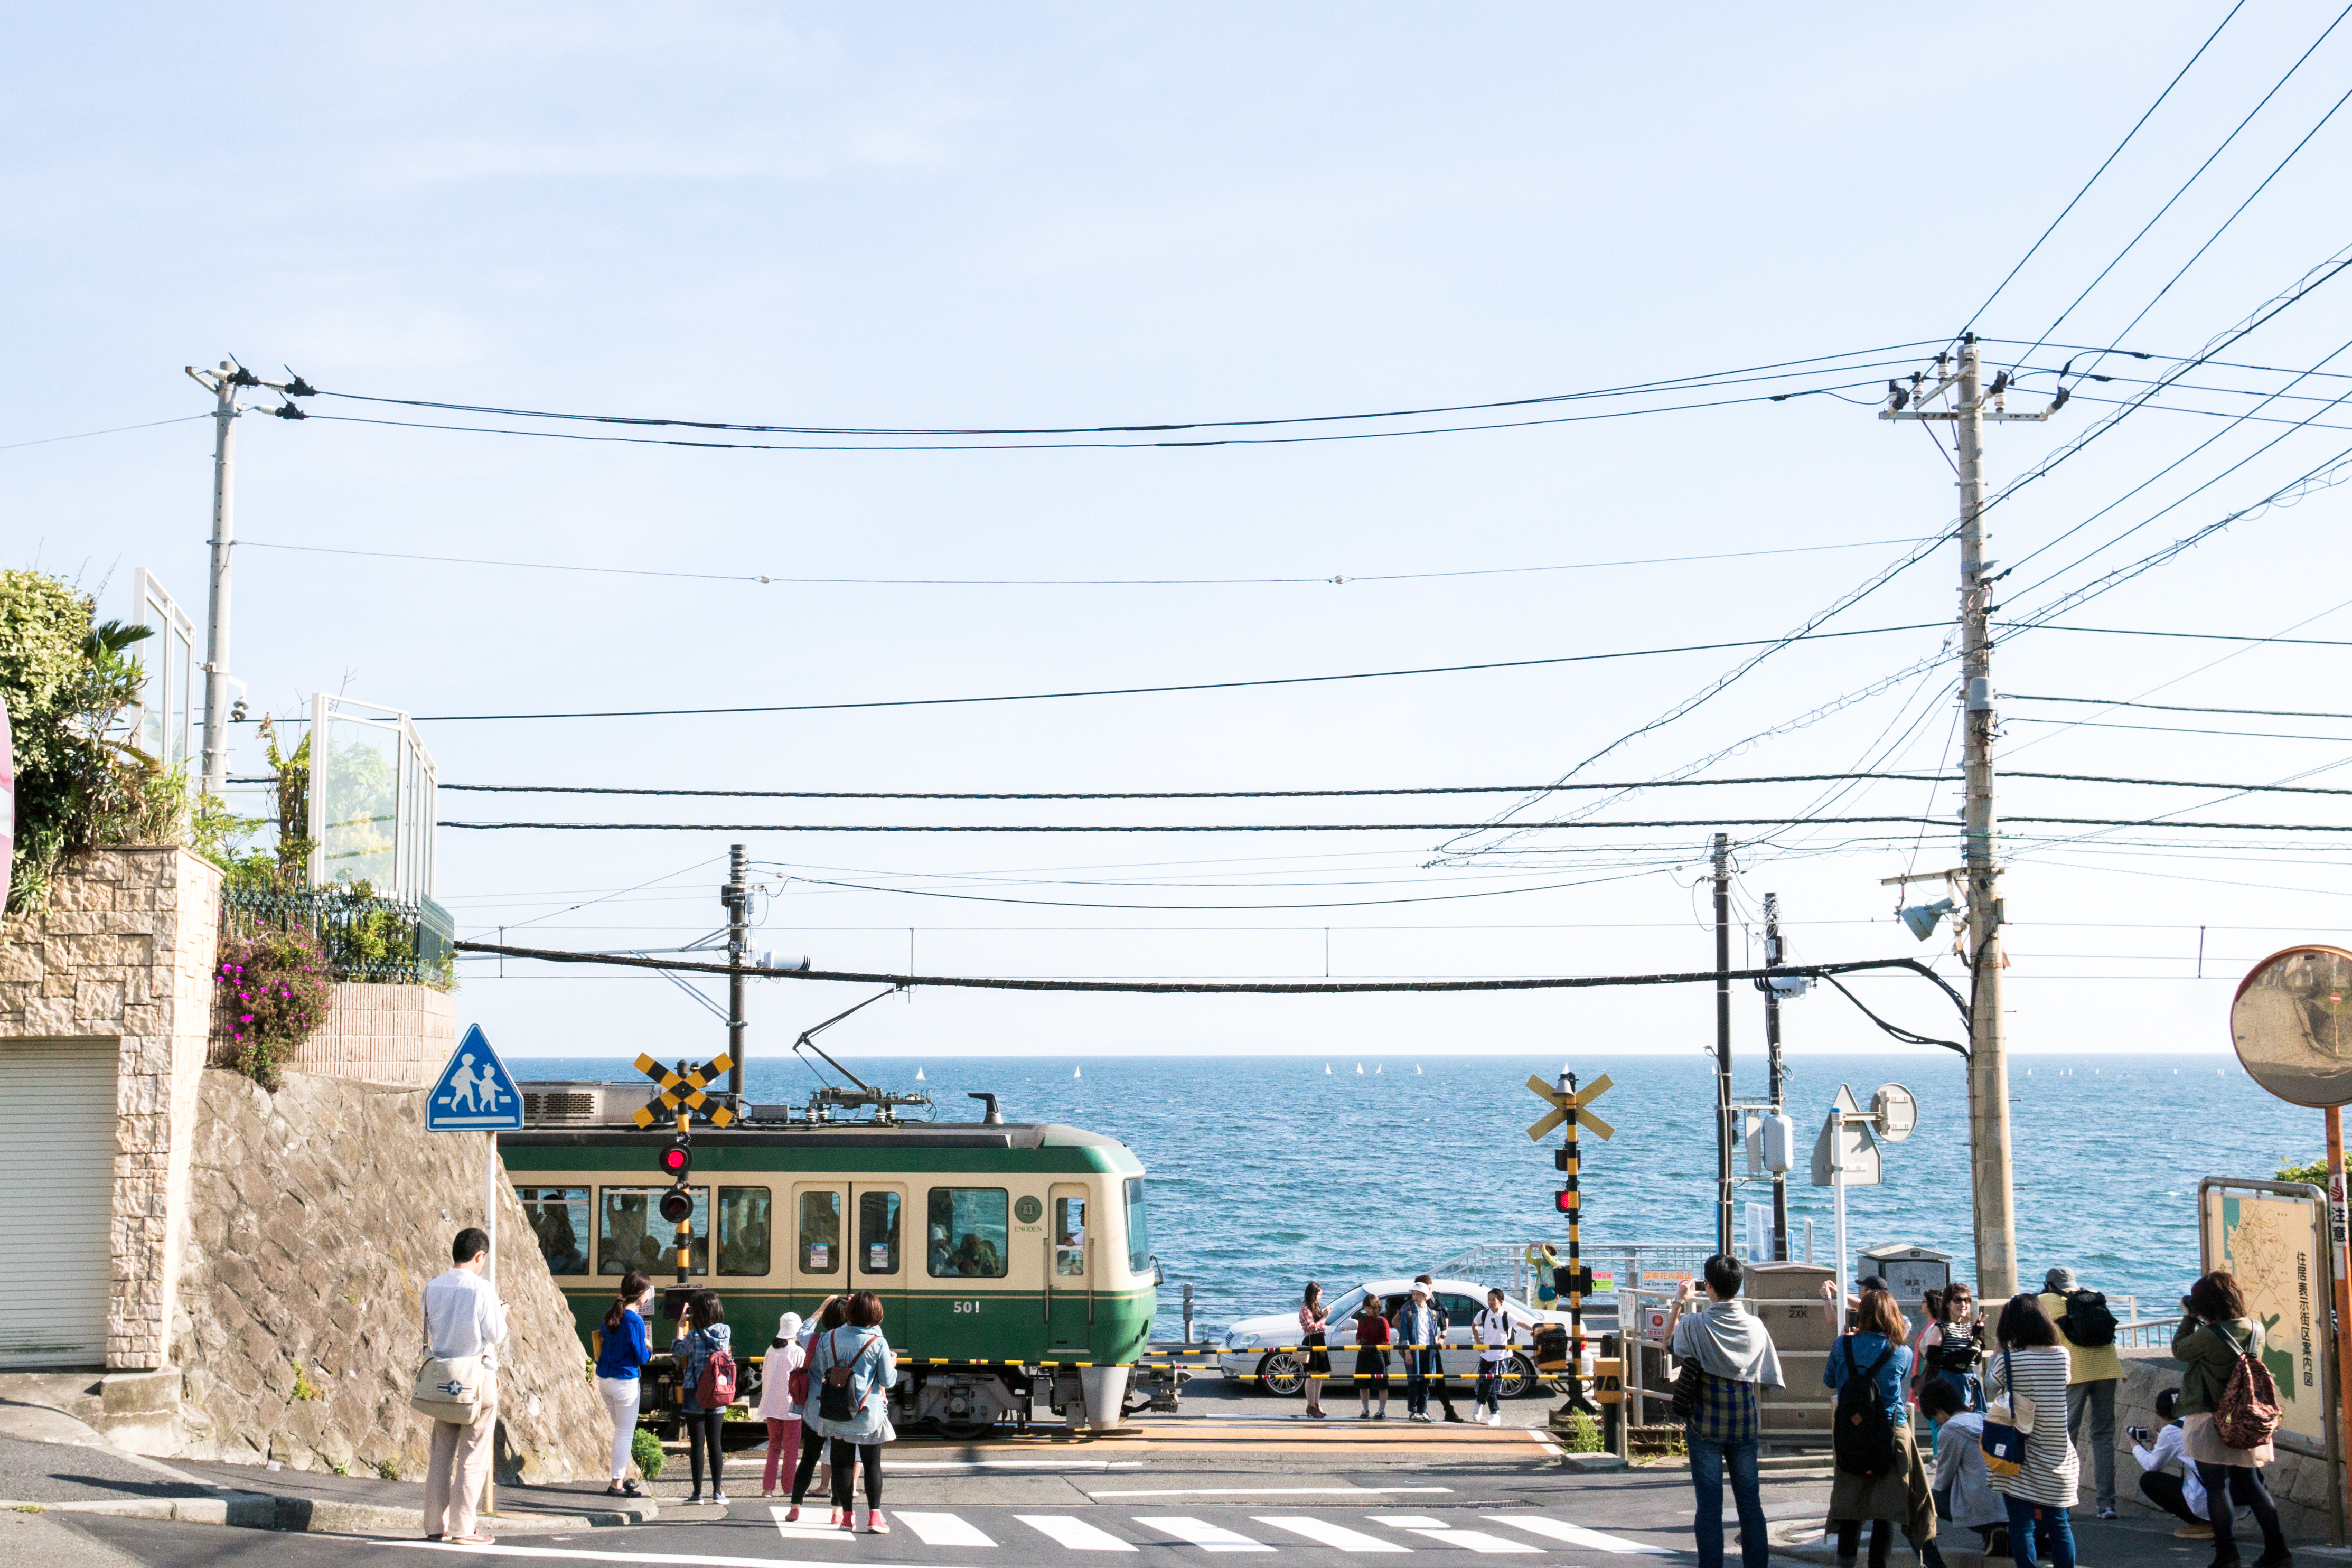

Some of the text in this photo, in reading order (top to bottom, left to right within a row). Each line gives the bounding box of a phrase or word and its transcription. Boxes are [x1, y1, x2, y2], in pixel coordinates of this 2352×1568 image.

[2331, 1207, 2346, 1242] 注意
[953, 1301, 979, 1313] 501
[1789, 1309, 1807, 1318] 2XK
[2297, 1251, 2313, 1387] 住居表示街区案内図
